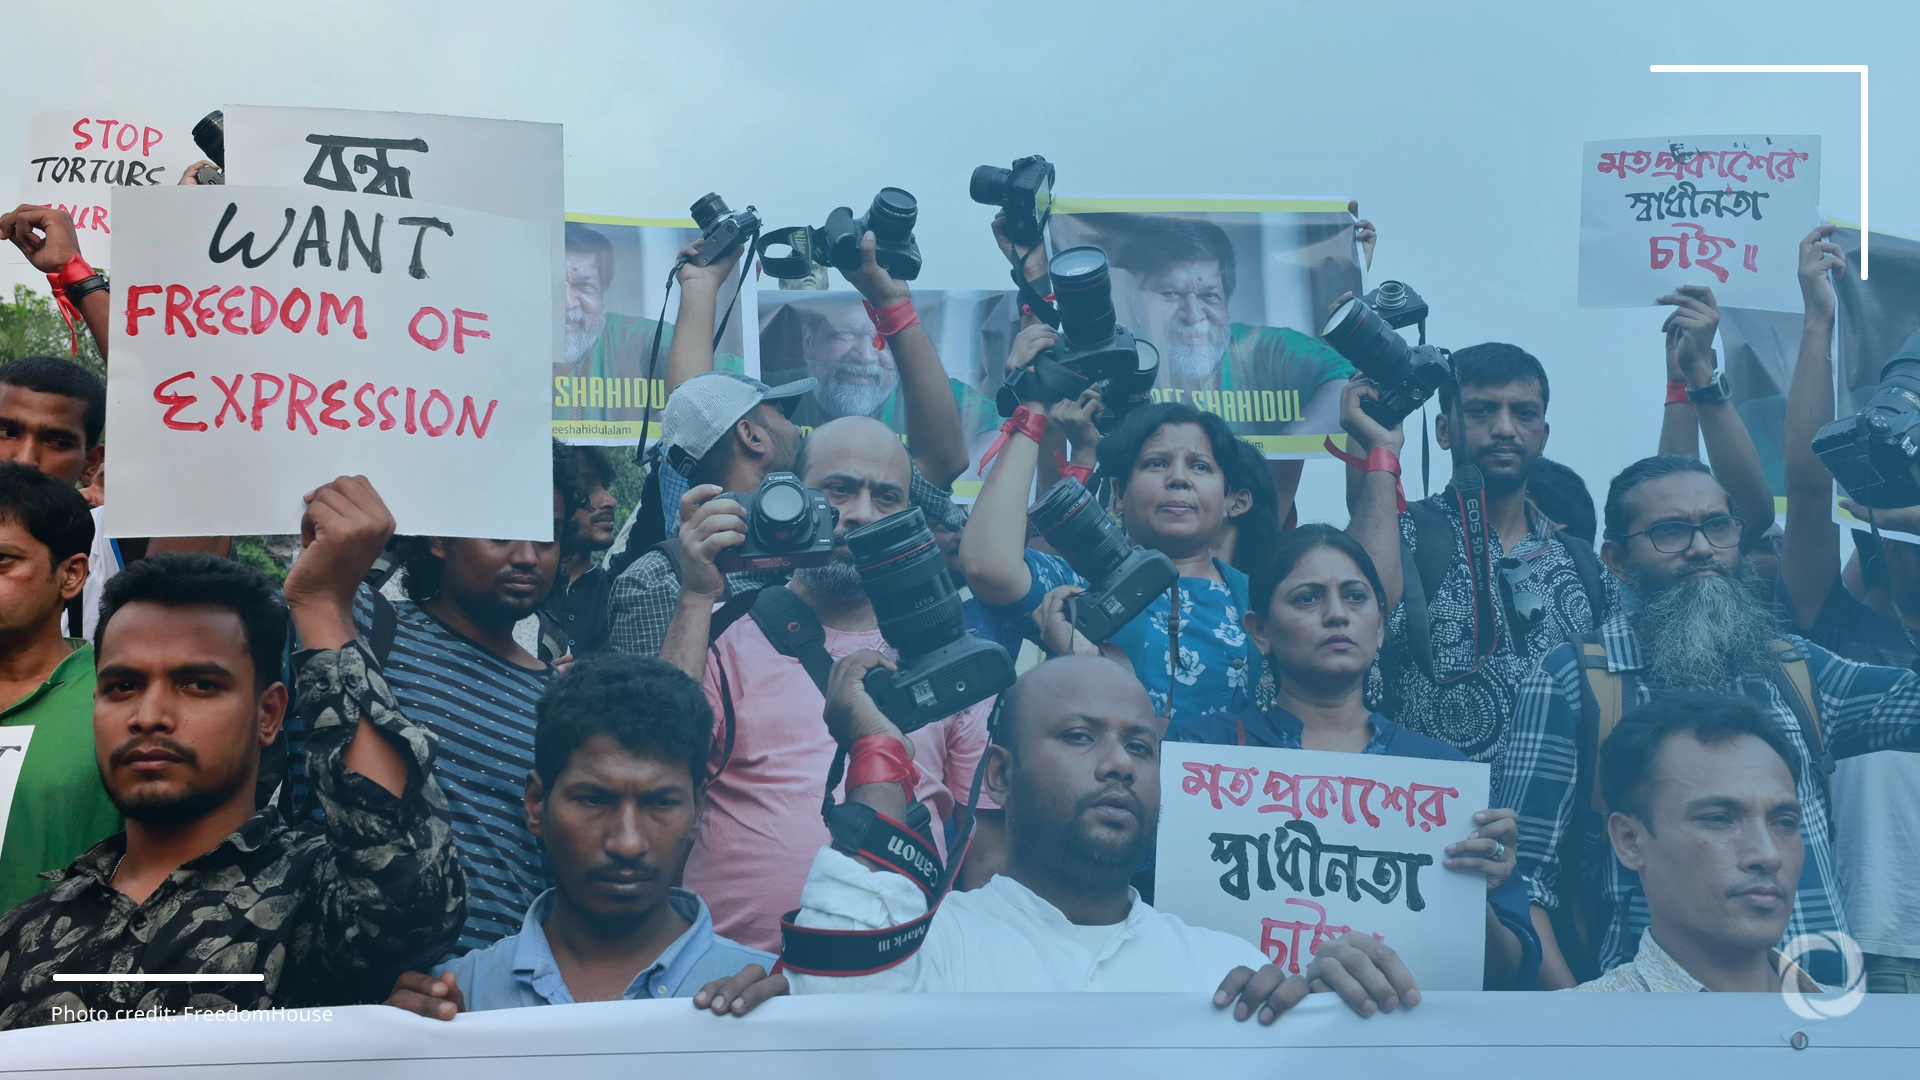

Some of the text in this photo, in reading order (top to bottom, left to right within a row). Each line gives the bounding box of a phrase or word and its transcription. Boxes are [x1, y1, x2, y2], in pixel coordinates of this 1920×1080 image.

[73, 117, 163, 157] STOP
[208, 201, 454, 279] WANT
[125, 284, 492, 354] FREEDOM OF
[154, 371, 499, 438] EXPRESSION
[554, 376, 665, 409] SHAHIDU
[1192, 389, 1305, 422] SHAHIDUL
[552, 424, 632, 435] eeshahidulalam
[1467, 498, 1481, 533] EOS
[1472, 537, 1484, 555] 5D
[1474, 557, 1482, 580] Mark
[1181, 761, 1460, 833] মত প্রকাশের
[887, 835, 939, 887] Canon
[1208, 819, 1434, 912] স্বাধীনতা
[878, 924, 926, 952] Mark III
